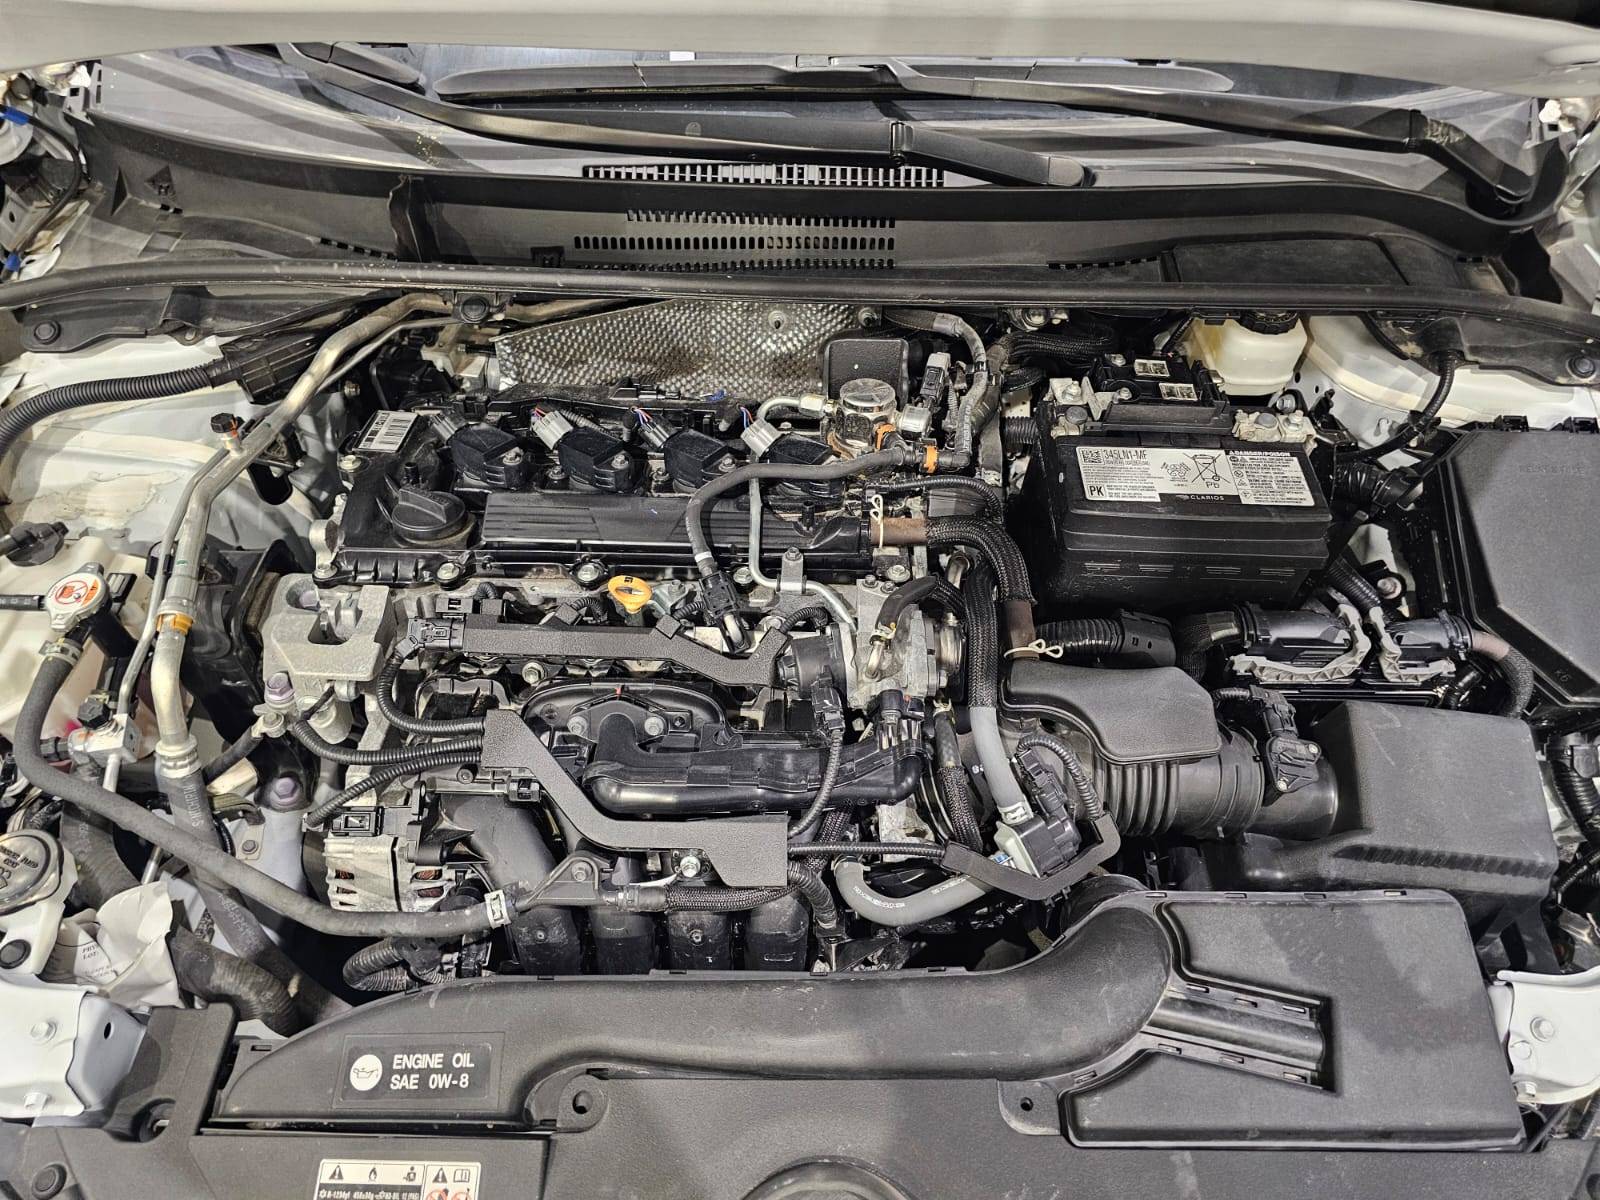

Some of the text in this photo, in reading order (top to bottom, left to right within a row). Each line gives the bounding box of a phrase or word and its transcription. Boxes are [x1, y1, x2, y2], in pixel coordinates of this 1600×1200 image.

[1089, 485, 1105, 497] PK
[392, 1052, 475, 1070] ENGINE OIL
[389, 1072, 469, 1090] SAE 0W-8
